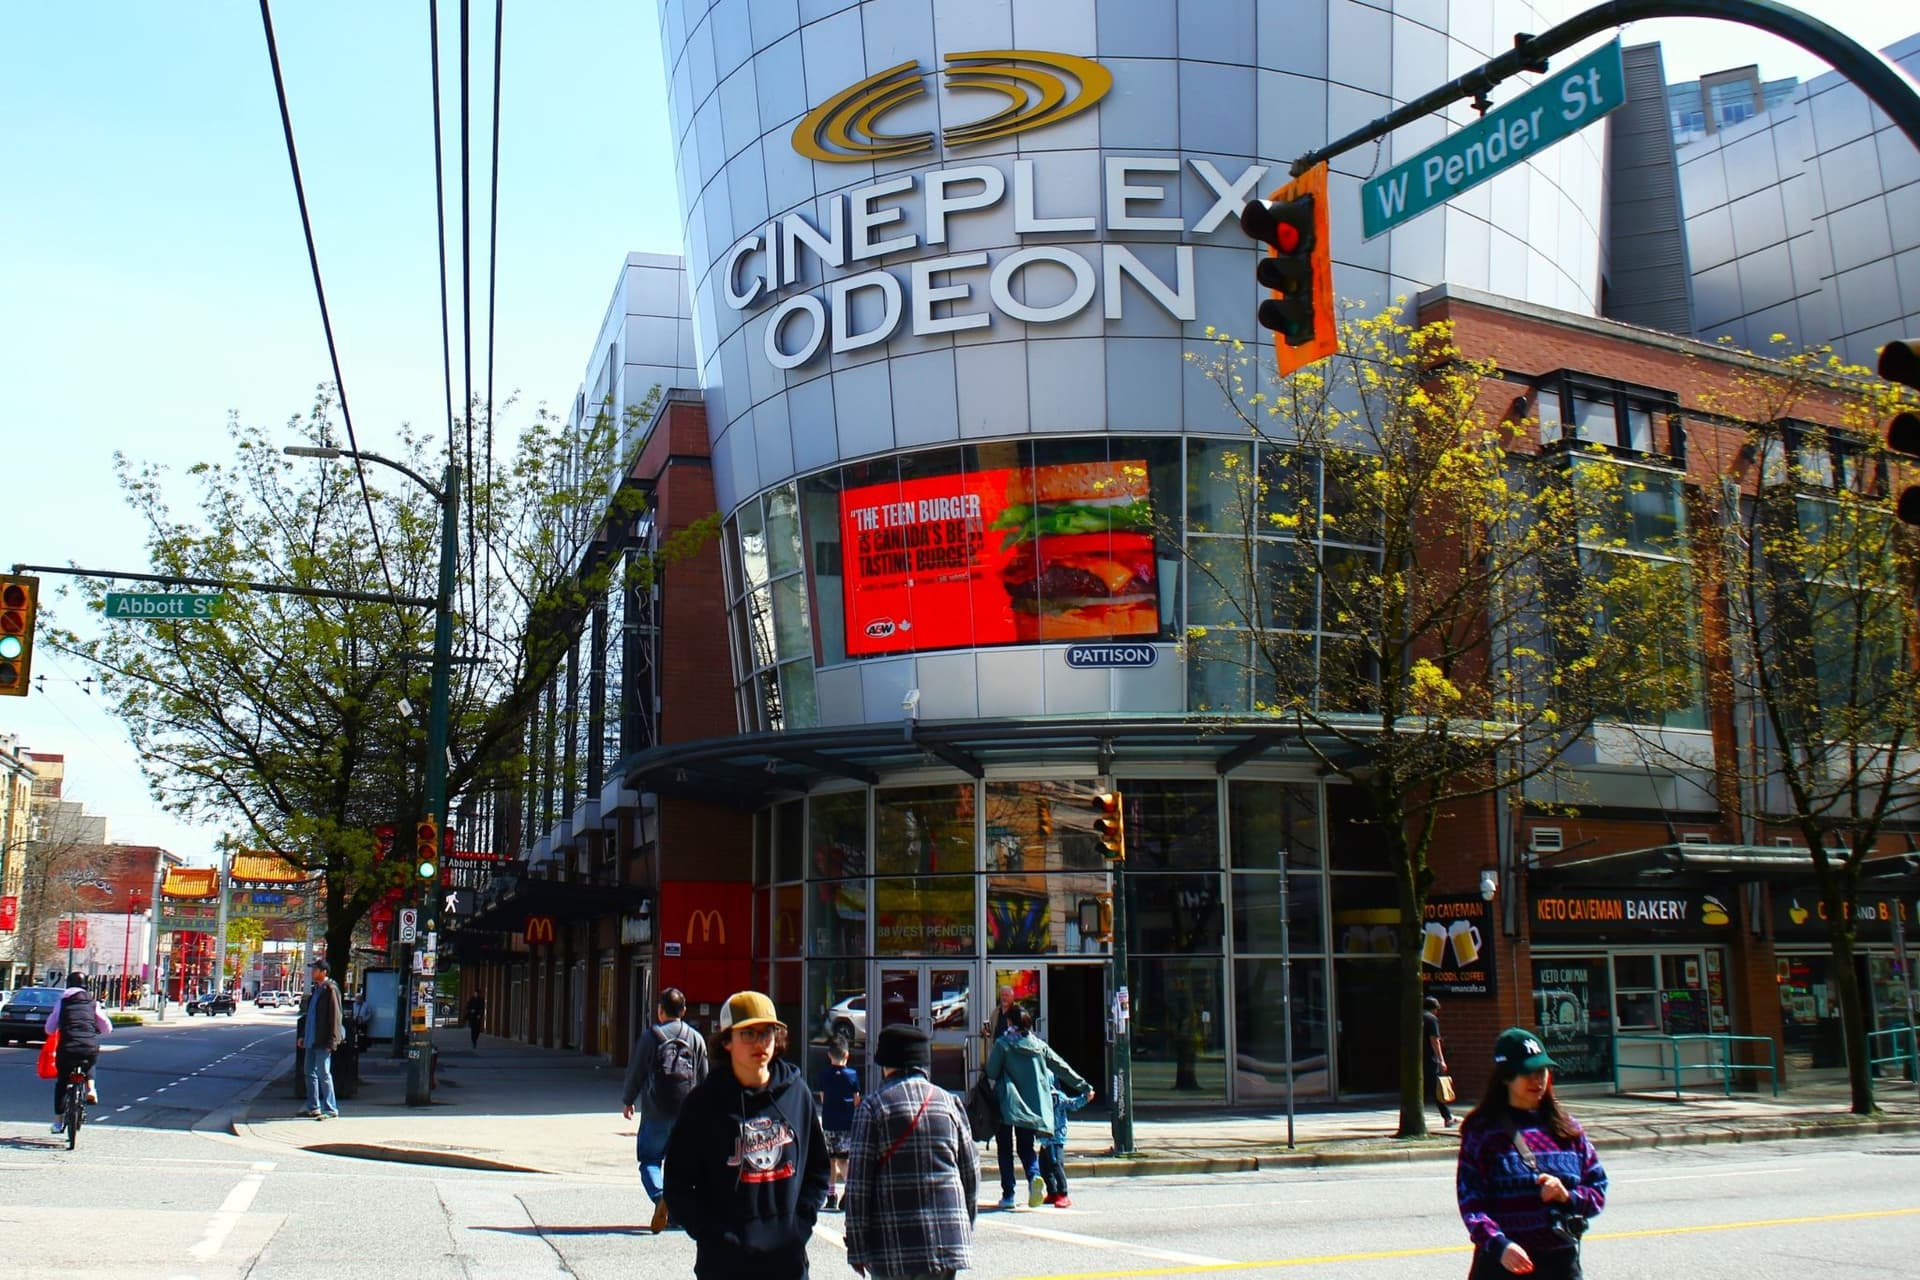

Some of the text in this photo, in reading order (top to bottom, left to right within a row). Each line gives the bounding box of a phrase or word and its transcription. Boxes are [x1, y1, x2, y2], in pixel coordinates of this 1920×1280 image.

[1376, 66, 1604, 219] W Pender St
[723, 156, 1272, 310] CINEPLEX
[763, 244, 1197, 370] ODEON
[881, 501, 916, 527] TEEN
[918, 494, 981, 523] BURGER
[858, 532, 871, 553] IS
[858, 551, 912, 577] TASTING
[117, 597, 214, 615] Abbott St
[1072, 646, 1150, 663] PATTISON
[448, 858, 491, 869] Abbott St
[1423, 902, 1485, 918] TO CAVEMAN
[1537, 899, 1688, 920] KETO CAVEMAN BAKERY
[1878, 901, 1908, 921] BR
[892, 926, 925, 937] WEST
[926, 924, 976, 937] PENDER
